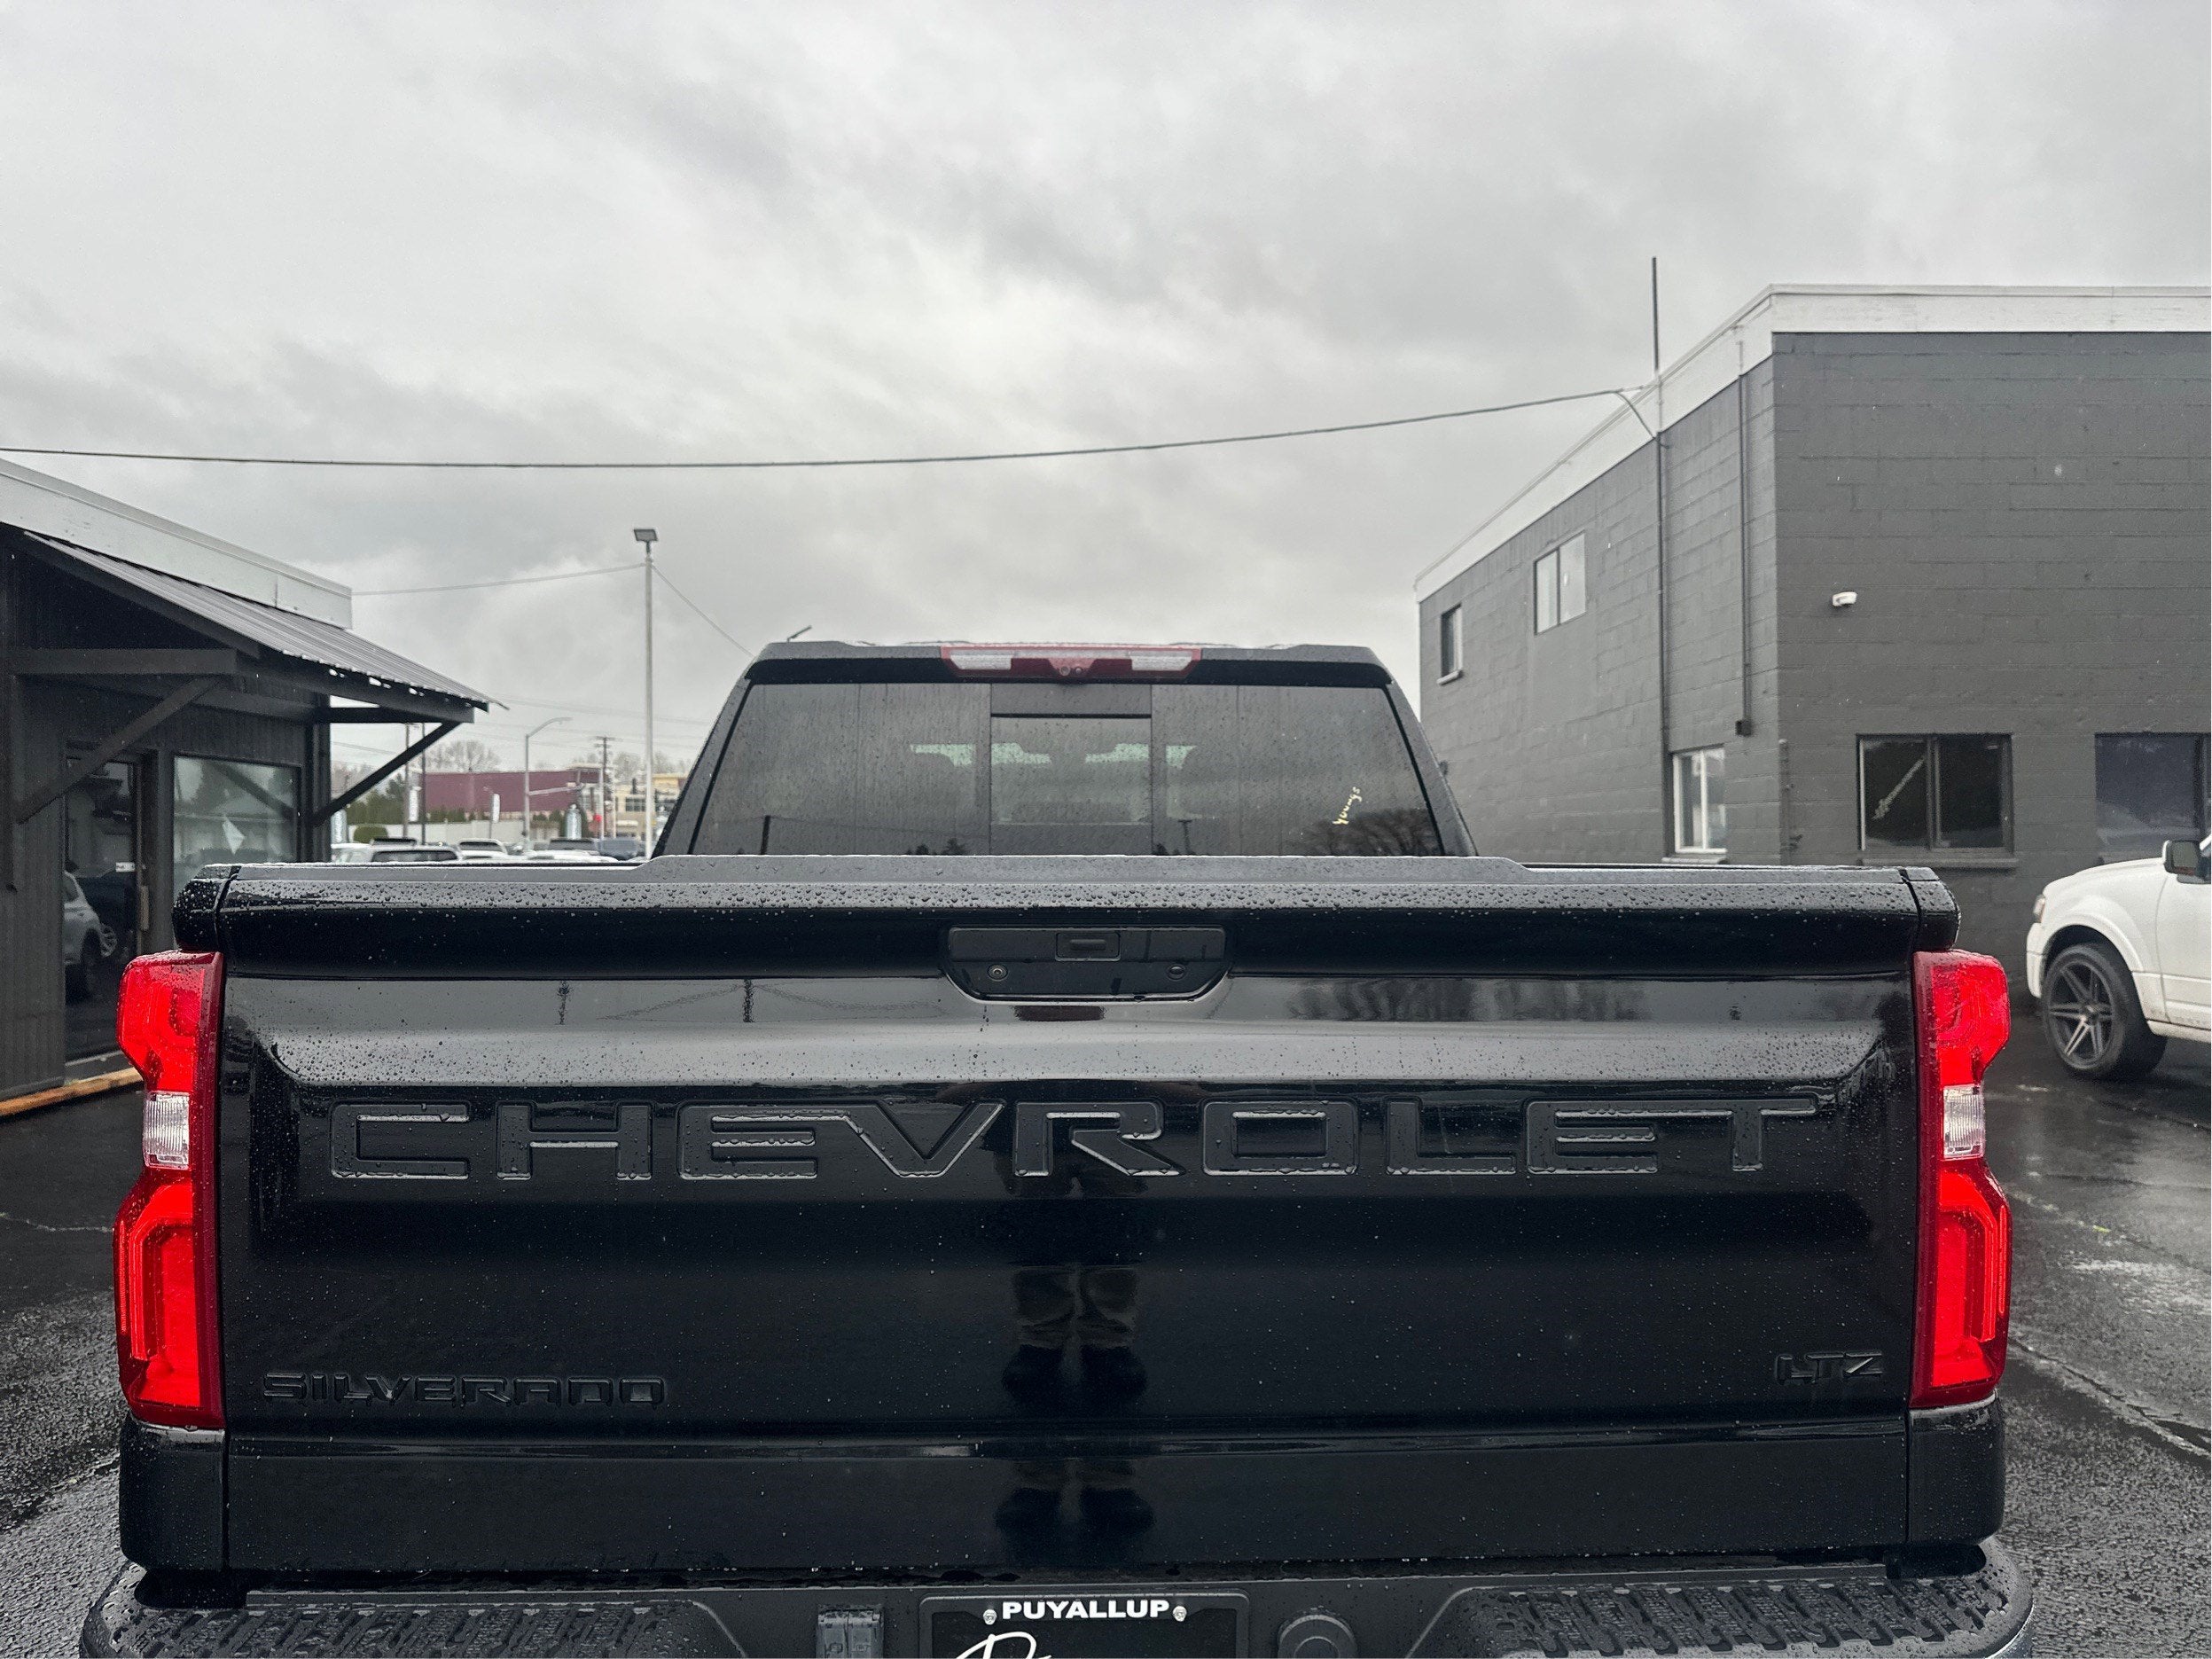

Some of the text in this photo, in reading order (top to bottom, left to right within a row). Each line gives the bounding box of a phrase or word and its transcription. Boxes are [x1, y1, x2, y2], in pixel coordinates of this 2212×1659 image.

[331, 1097, 1817, 1181] CHEVROLET
[1774, 1351, 1883, 1383] LTZ
[263, 1372, 665, 1407] SILVERADO
[1002, 1600, 1169, 1620] PUYALLUP
